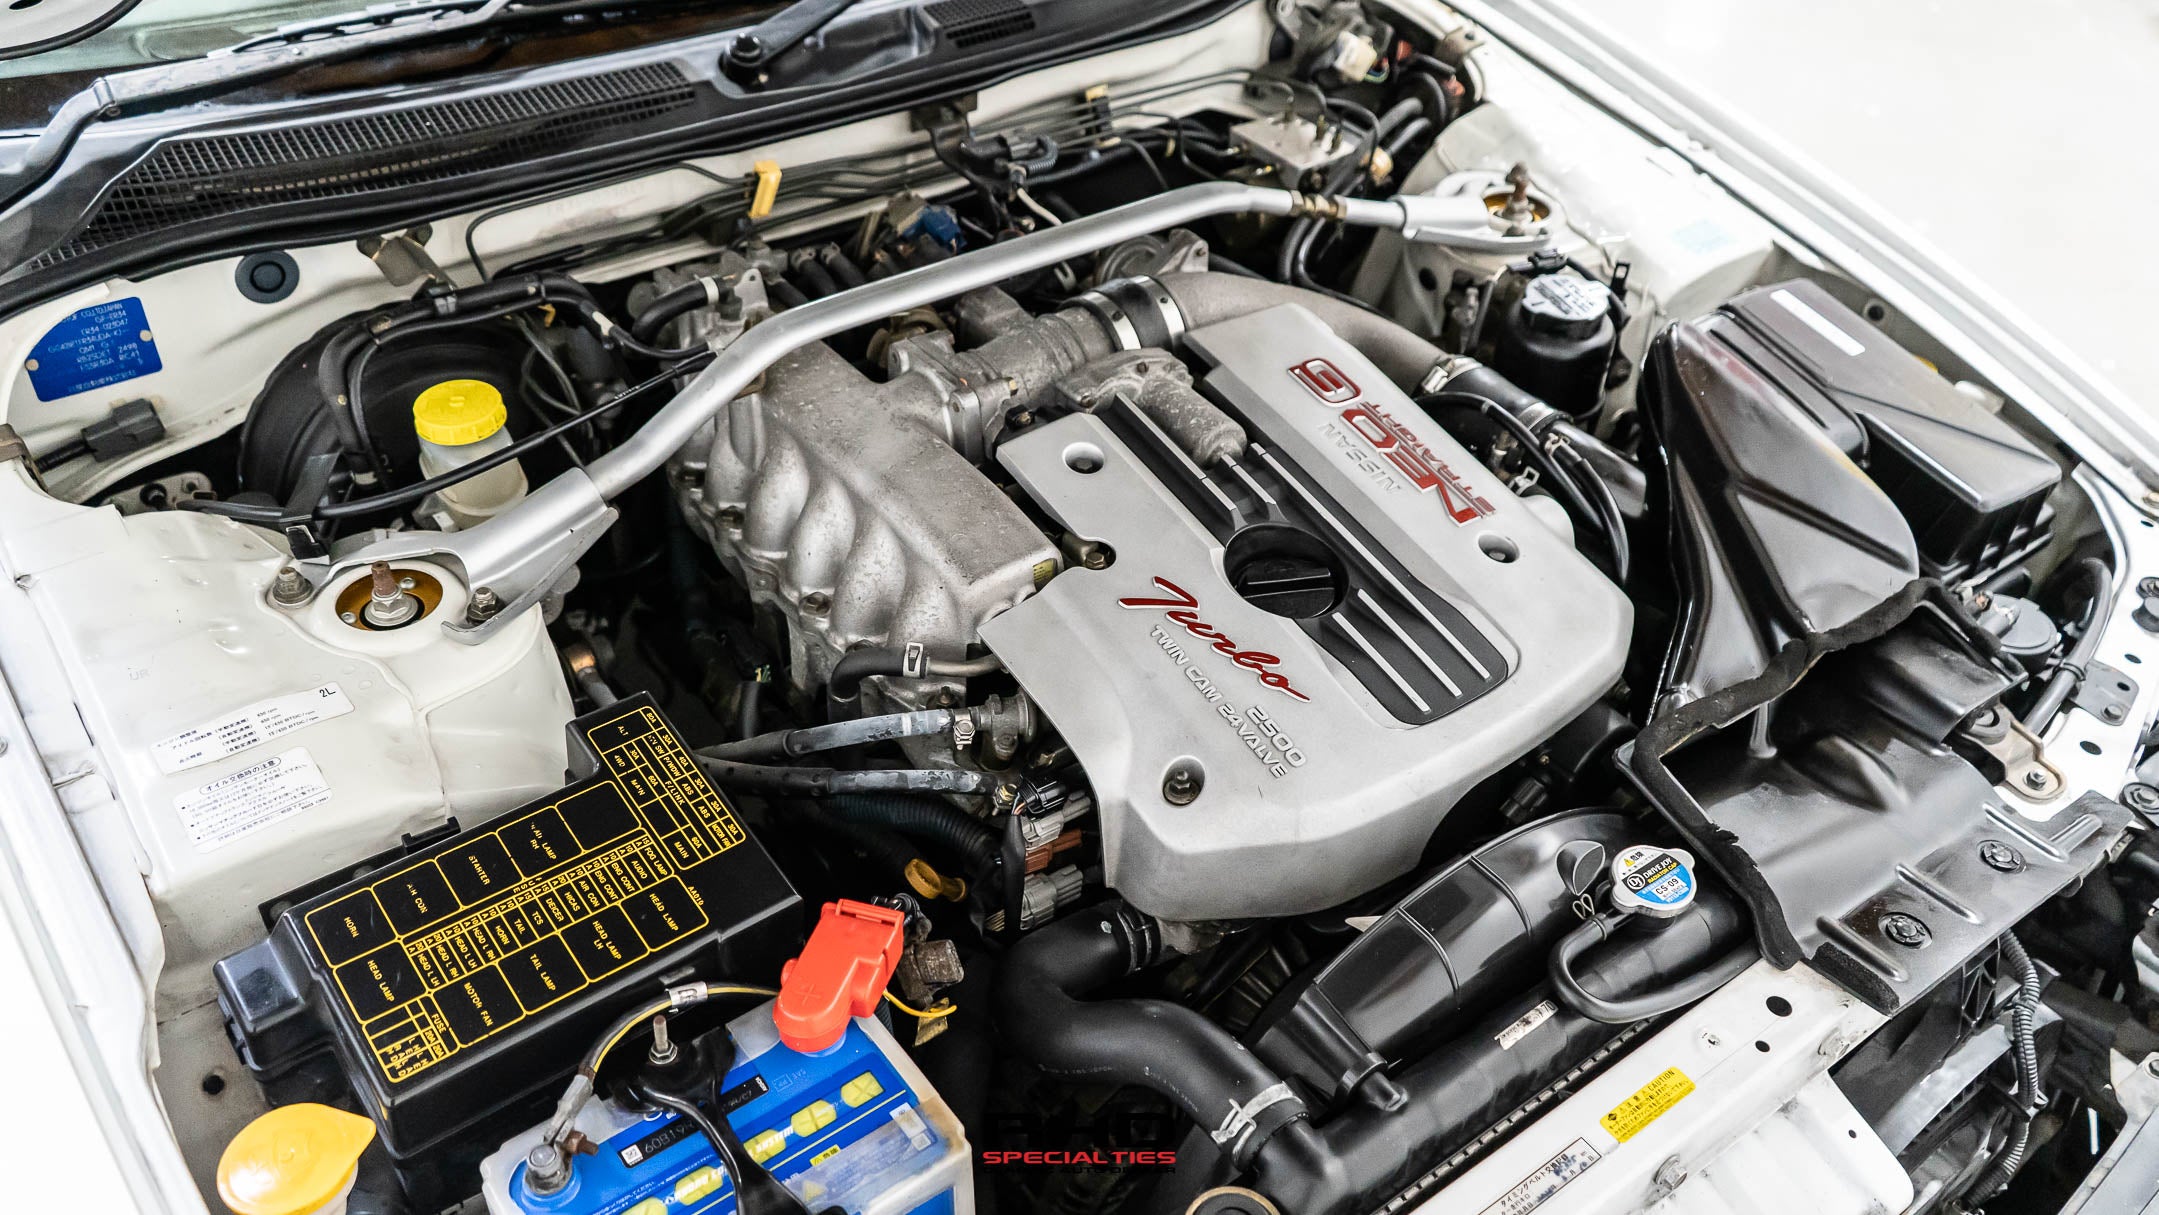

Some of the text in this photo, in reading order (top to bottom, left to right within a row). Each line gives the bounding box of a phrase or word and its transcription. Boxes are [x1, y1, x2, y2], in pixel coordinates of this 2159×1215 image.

[1317, 423, 1402, 494] NISSAN
[1118, 576, 1311, 703] Turbo
[1151, 625, 1189, 665] TWIN
[1185, 665, 1223, 702] CAM
[319, 686, 335, 697] 2L
[1246, 705, 1307, 768] 2500
[207, 759, 275, 791] オイル交換時の注意
[618, 726, 628, 735] ALT
[655, 745, 665, 754] SW
[682, 784, 694, 795] ABS
[698, 806, 710, 818] ABS
[614, 755, 625, 767] 4WD
[674, 842, 689, 858] MAIN
[665, 781, 685, 805] F/LINK
[694, 778, 705, 789] 30A
[711, 801, 721, 812] 30A
[728, 824, 738, 835] 30A
[530, 839, 540, 849] RH
[542, 842, 556, 859] LAMP
[469, 856, 490, 885] STARTER
[632, 861, 647, 879] AUDIO
[644, 847, 668, 875] FOG LAMP
[1642, 863, 1662, 878] DRIVE
[1660, 856, 1672, 867] JOY
[594, 870, 618, 900] ENG CONT
[612, 862, 635, 892] ENG CONT
[1655, 877, 1679, 895] CS-09
[415, 898, 428, 913] CON
[564, 892, 580, 911] HICAS
[579, 880, 600, 907] AIR CON
[532, 911, 543, 925] TCS
[546, 898, 564, 922] DEICER
[650, 894, 678, 930] HEAD LAMP
[344, 917, 359, 938] HORN
[495, 925, 510, 944] HORN
[514, 919, 525, 934] TAIL
[593, 921, 622, 959] HEAD LAMP
[454, 936, 468, 953] HEAD
[468, 959, 477, 968] LH
[472, 927, 486, 944] HEAD
[486, 950, 496, 960] RH
[594, 939, 604, 950] LH
[417, 953, 431, 970] HEAD
[430, 976, 440, 986] LH
[436, 944, 449, 961] HEAD
[449, 967, 459, 978] RH
[530, 954, 556, 990] TAIL LAMP
[368, 960, 394, 1001] HEAD LAMP
[464, 982, 493, 1026] MOTOR FAN
[424, 1030, 438, 1044] 20A
[431, 1013, 446, 1034] FUSE
[1647, 1069, 1675, 1091] CAUTION
